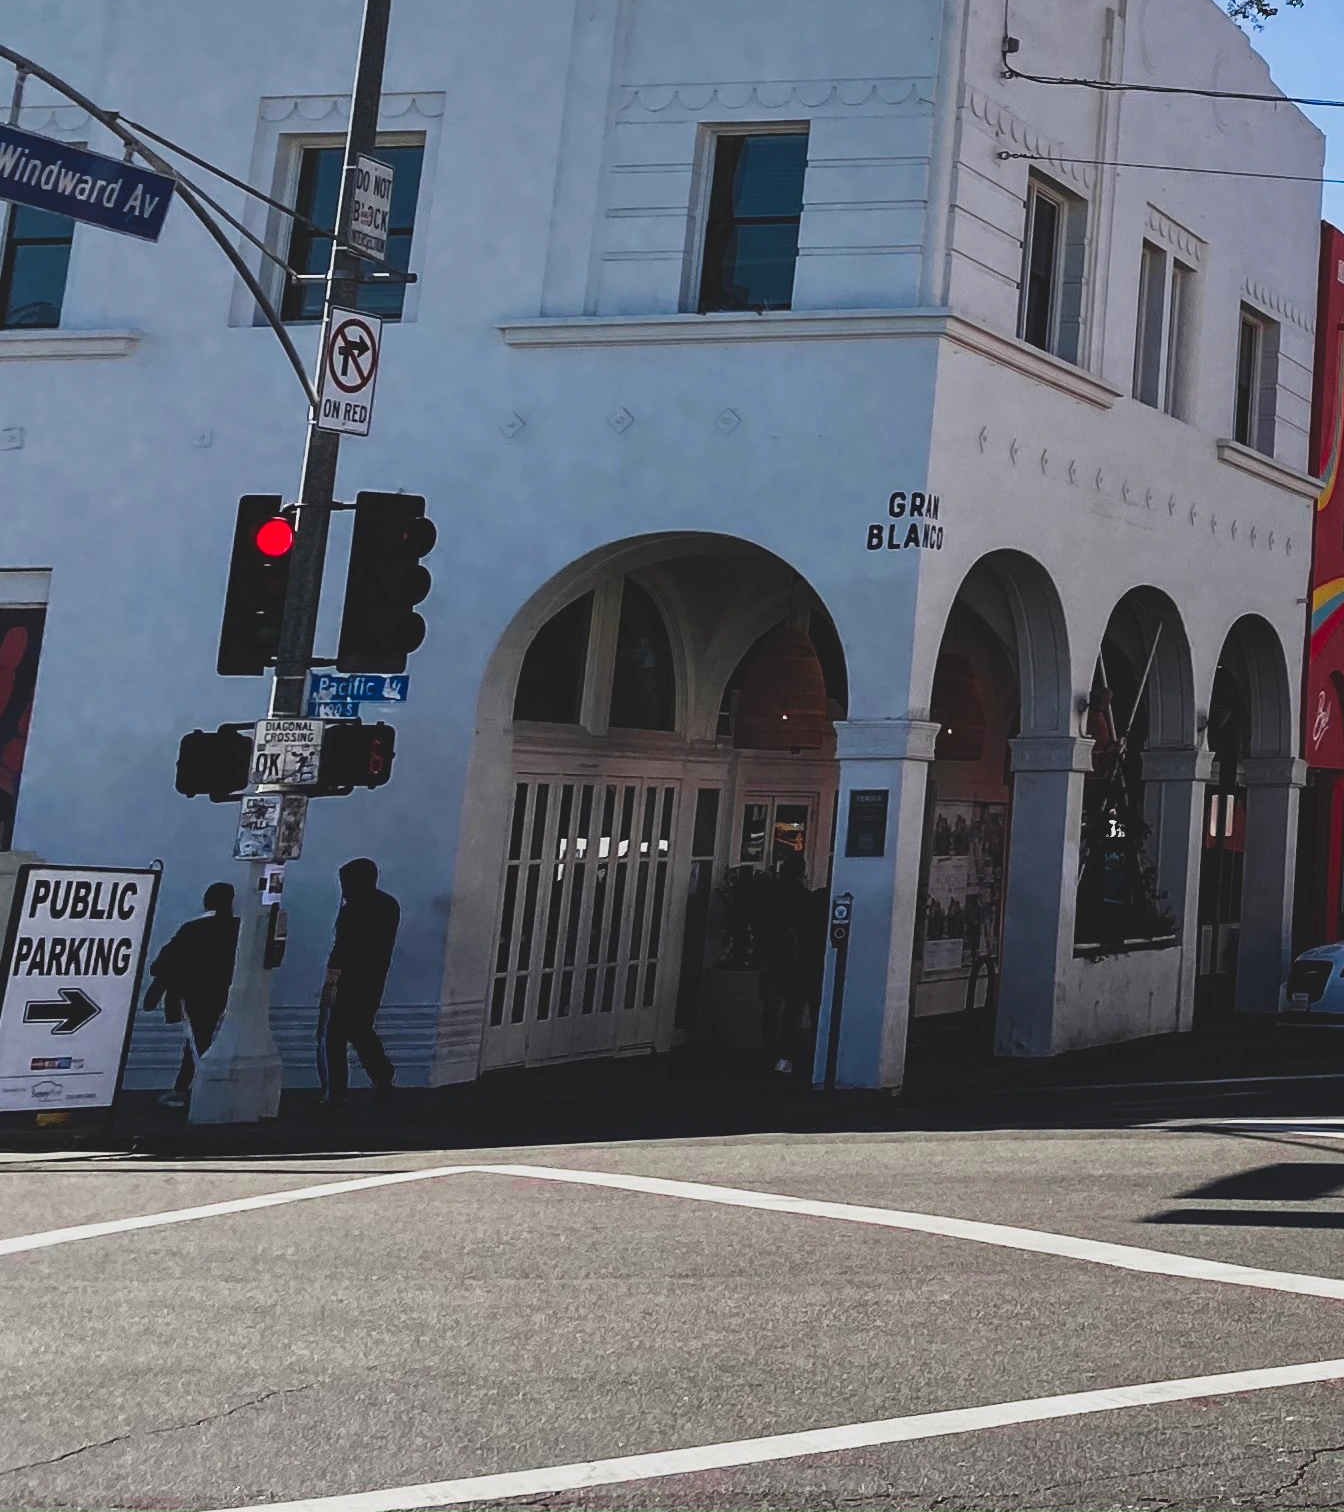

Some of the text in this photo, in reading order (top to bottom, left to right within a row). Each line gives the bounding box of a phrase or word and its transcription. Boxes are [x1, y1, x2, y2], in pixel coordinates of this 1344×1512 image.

[0, 142, 160, 219] Windward Av
[356, 168, 392, 200] DO NOT
[323, 399, 368, 424] ON RED
[888, 491, 940, 521] GRAN
[866, 522, 944, 550] BLANCO
[319, 677, 375, 696] Pacific
[264, 732, 315, 744] CROSSING
[265, 722, 314, 732] DIAGONAL
[255, 753, 282, 777] OK
[28, 879, 139, 920] PUBLIC
[11, 936, 133, 977] PARKING
